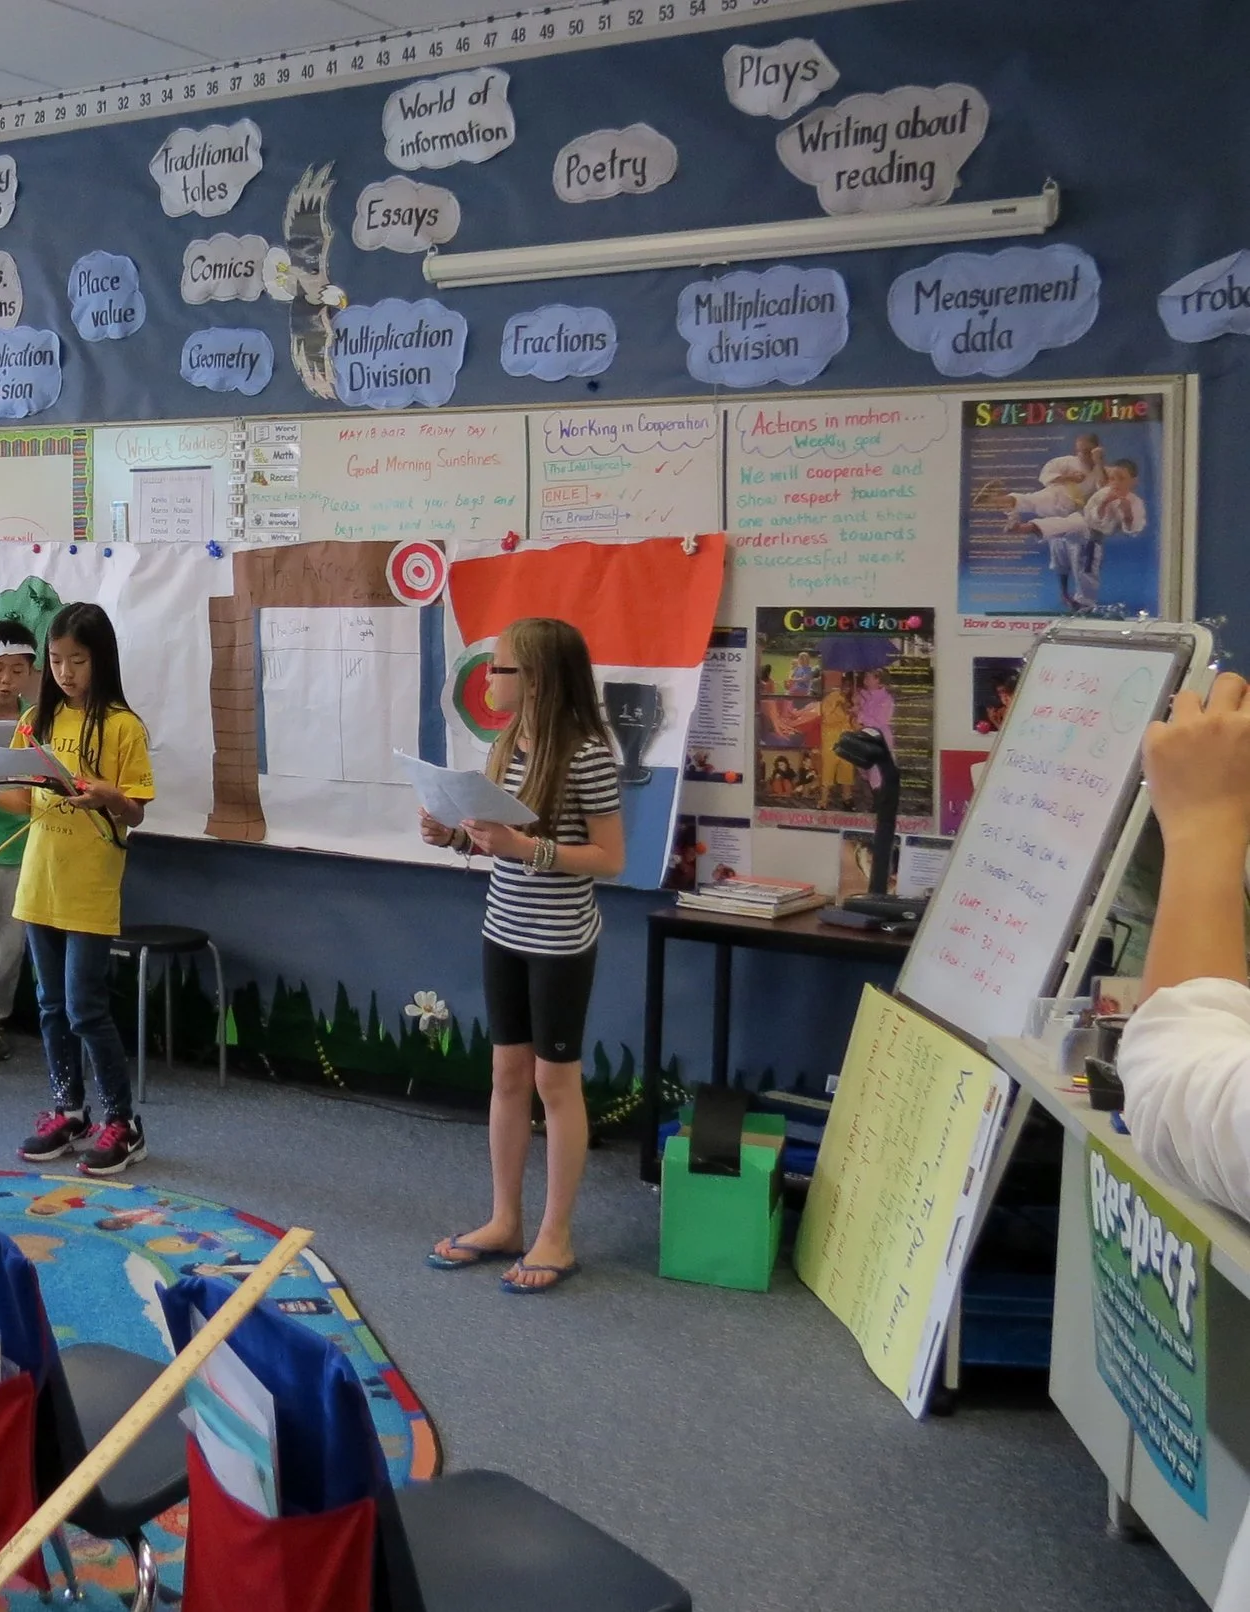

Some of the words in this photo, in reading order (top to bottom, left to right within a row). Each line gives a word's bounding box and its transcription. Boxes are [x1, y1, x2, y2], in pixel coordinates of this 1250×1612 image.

[351, 56, 364, 71] 42
[455, 37, 470, 54] 46
[568, 19, 584, 35] 50
[739, 54, 819, 102] Plays
[76, 104, 87, 118] 30
[161, 89, 173, 103] 34
[253, 72, 266, 87] 38
[399, 86, 455, 121] World
[469, 75, 495, 105] of
[400, 121, 508, 158] information
[798, 115, 887, 156] Writing
[896, 99, 973, 138] about
[162, 134, 250, 175] Traditional
[566, 151, 648, 188] Poetry
[836, 152, 935, 193] reading
[183, 176, 229, 205] tales
[366, 200, 439, 237] Essays
[79, 271, 120, 297] Place
[190, 255, 254, 283] Comics
[695, 283, 835, 328] Multiplication
[914, 264, 1080, 316] Measurement
[92, 307, 135, 327] value
[333, 319, 453, 358] Multiplication
[513, 325, 607, 356] Fractions
[709, 332, 799, 365] division
[952, 321, 1014, 356] data
[189, 343, 259, 382] Geometry
[349, 361, 431, 392] Division
[751, 411, 817, 436] Actions
[825, 413, 839, 428] in
[974, 399, 1148, 425] Self-Discipline
[179, 435, 224, 451] Buddies
[275, 425, 297, 433] Word
[276, 433, 298, 442] Study
[339, 429, 363, 442] MAY
[365, 428, 376, 439] 18
[381, 428, 406, 438] 2012
[419, 425, 455, 436] FRIDAY
[467, 425, 485, 436] DAY
[559, 418, 618, 443] Working
[622, 422, 634, 433] in
[638, 413, 709, 436] Cooperation
[794, 434, 846, 451] Weekly
[272, 450, 294, 460] Math
[347, 455, 379, 478] Good
[386, 455, 432, 481] Morning
[437, 447, 499, 468] Sunshines
[740, 467, 765, 485] We
[770, 465, 798, 481] will
[806, 464, 883, 483] cooperate
[892, 459, 923, 475] and
[784, 489, 841, 508] respect
[851, 486, 916, 500] towards
[736, 532, 828, 548] orderliness
[839, 528, 916, 543] towards
[784, 609, 913, 633] Cooperation
[963, 619, 989, 630] How
[991, 619, 1005, 630] do
[1006, 621, 1031, 633] you
[1089, 1150, 1197, 1339] Respect
